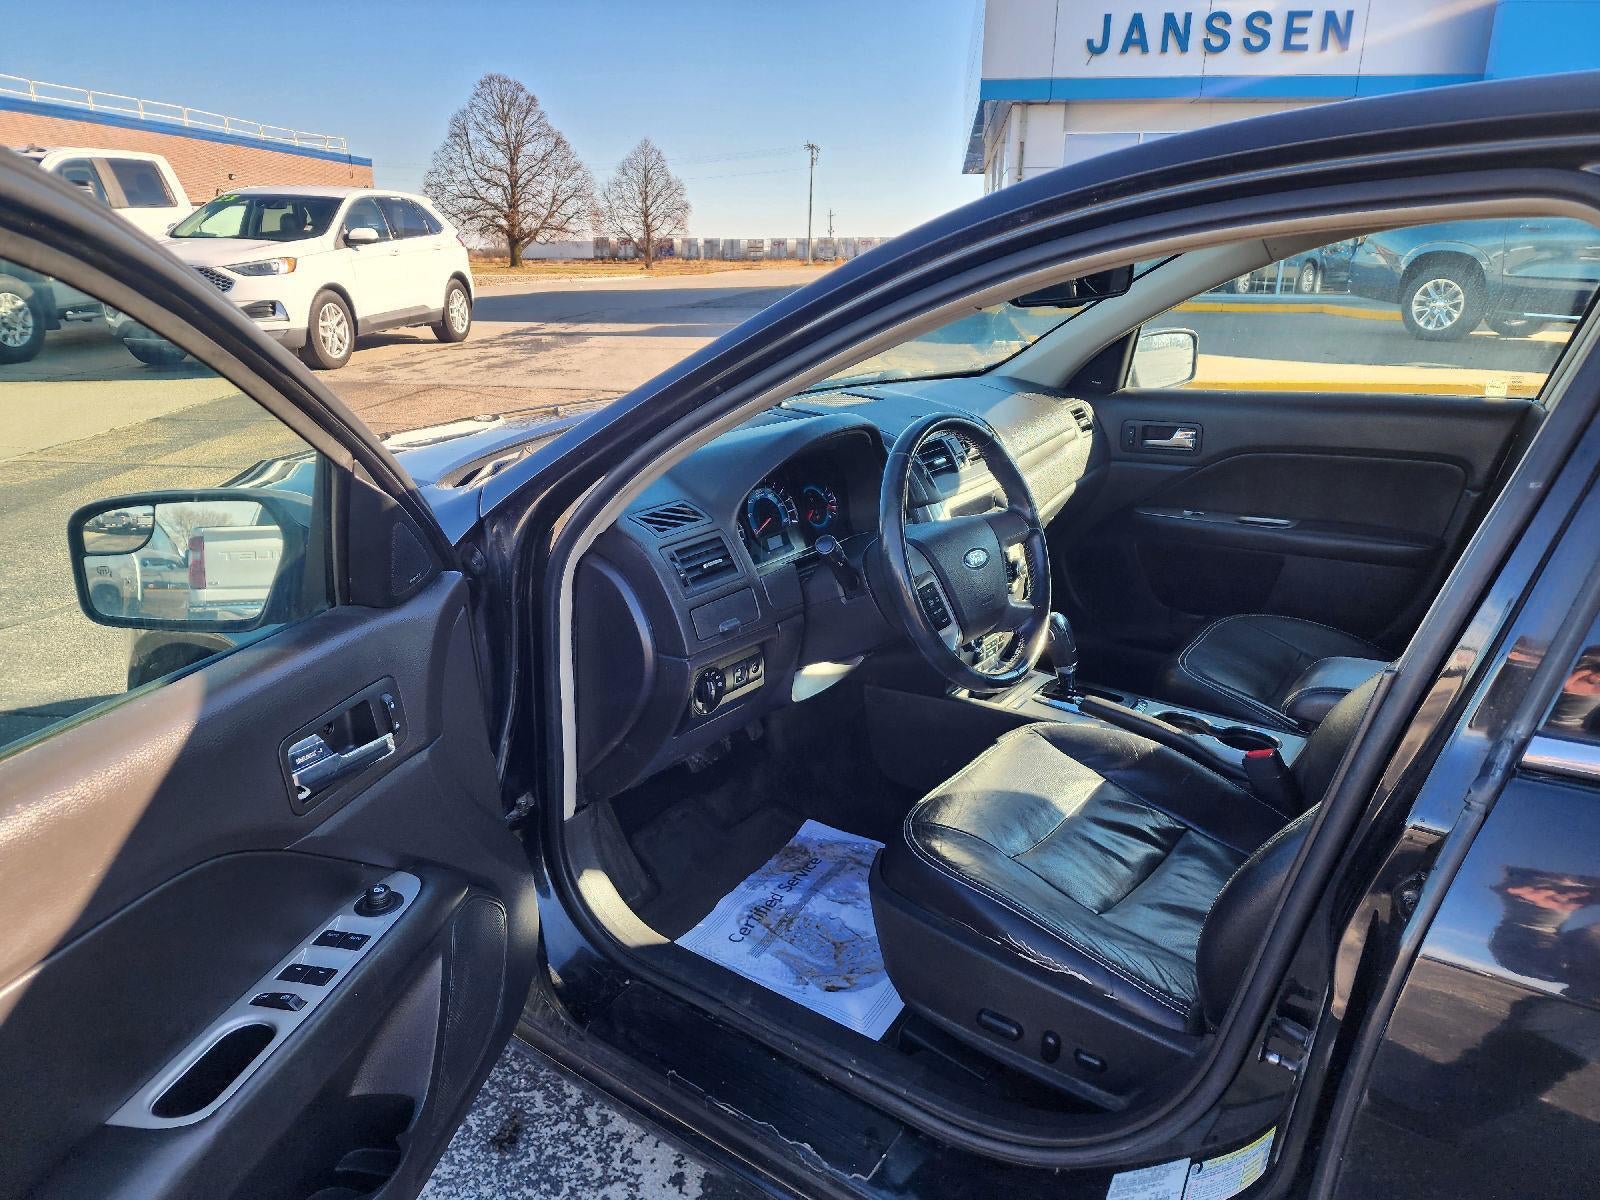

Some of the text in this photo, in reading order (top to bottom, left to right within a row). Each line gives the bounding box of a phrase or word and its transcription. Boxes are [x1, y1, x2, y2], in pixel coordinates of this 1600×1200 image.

[1086, 10, 1354, 54] JANSSEN
[728, 857, 822, 943] Certified Service
